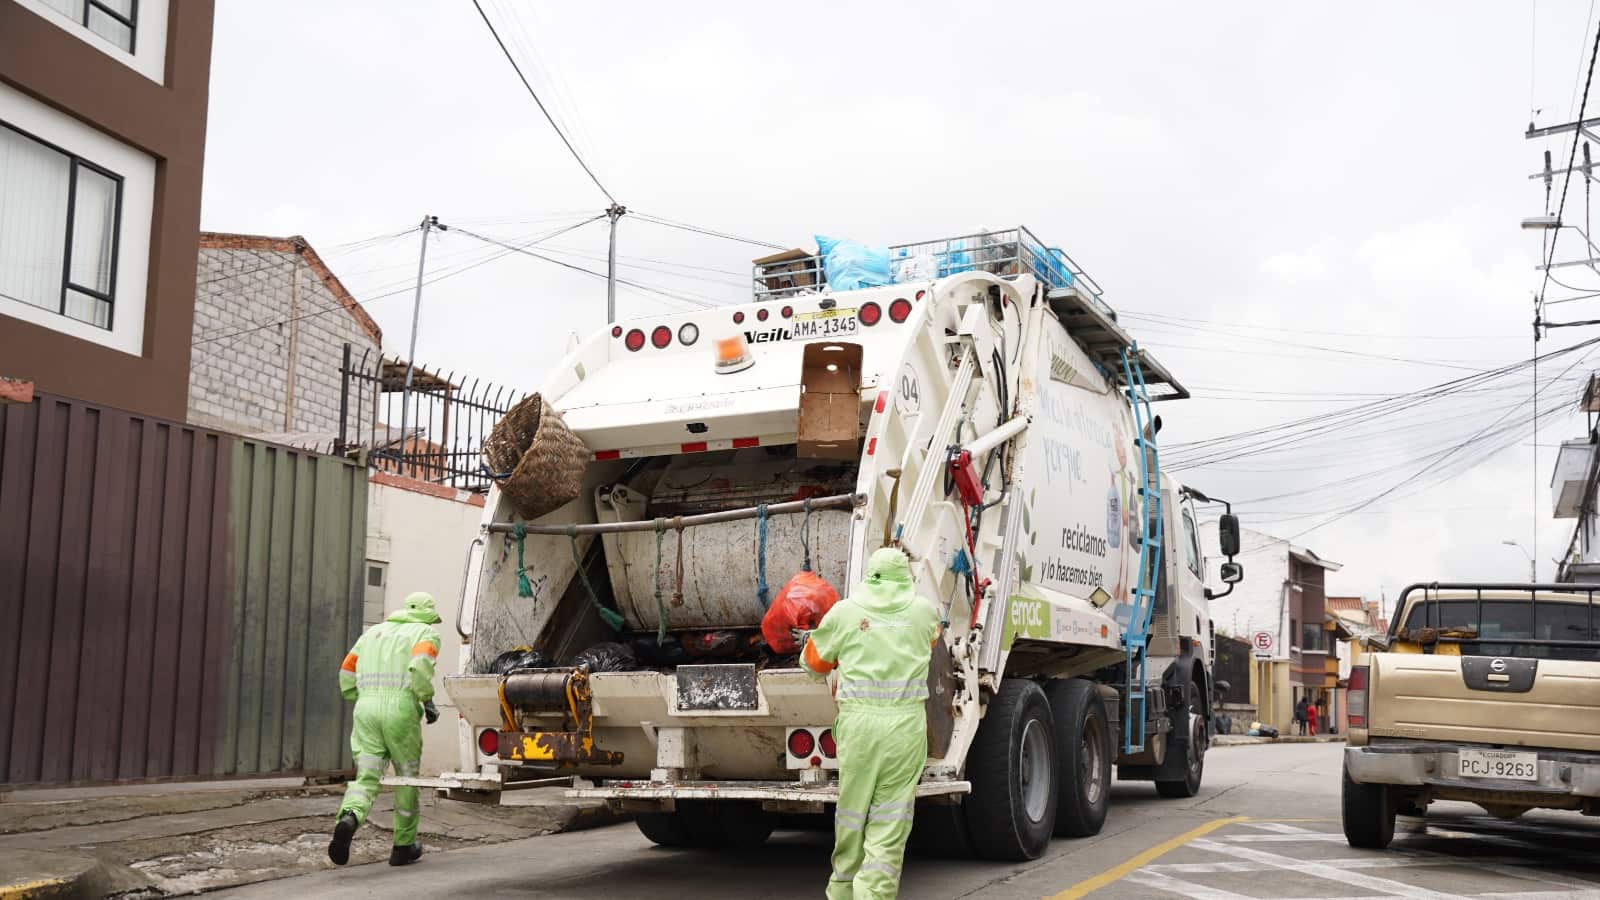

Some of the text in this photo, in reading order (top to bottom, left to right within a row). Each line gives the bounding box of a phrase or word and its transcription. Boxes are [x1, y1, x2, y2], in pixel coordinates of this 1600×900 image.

[794, 317, 856, 337] AMA-1345
[902, 374, 918, 404] 04
[1061, 523, 1106, 557] reciclamos
[1041, 561, 1046, 583] y
[1047, 555, 1055, 579] lo
[1055, 558, 1088, 585] hacemos
[1011, 601, 1042, 626] emac
[1462, 760, 1534, 777] PCJ-9263
